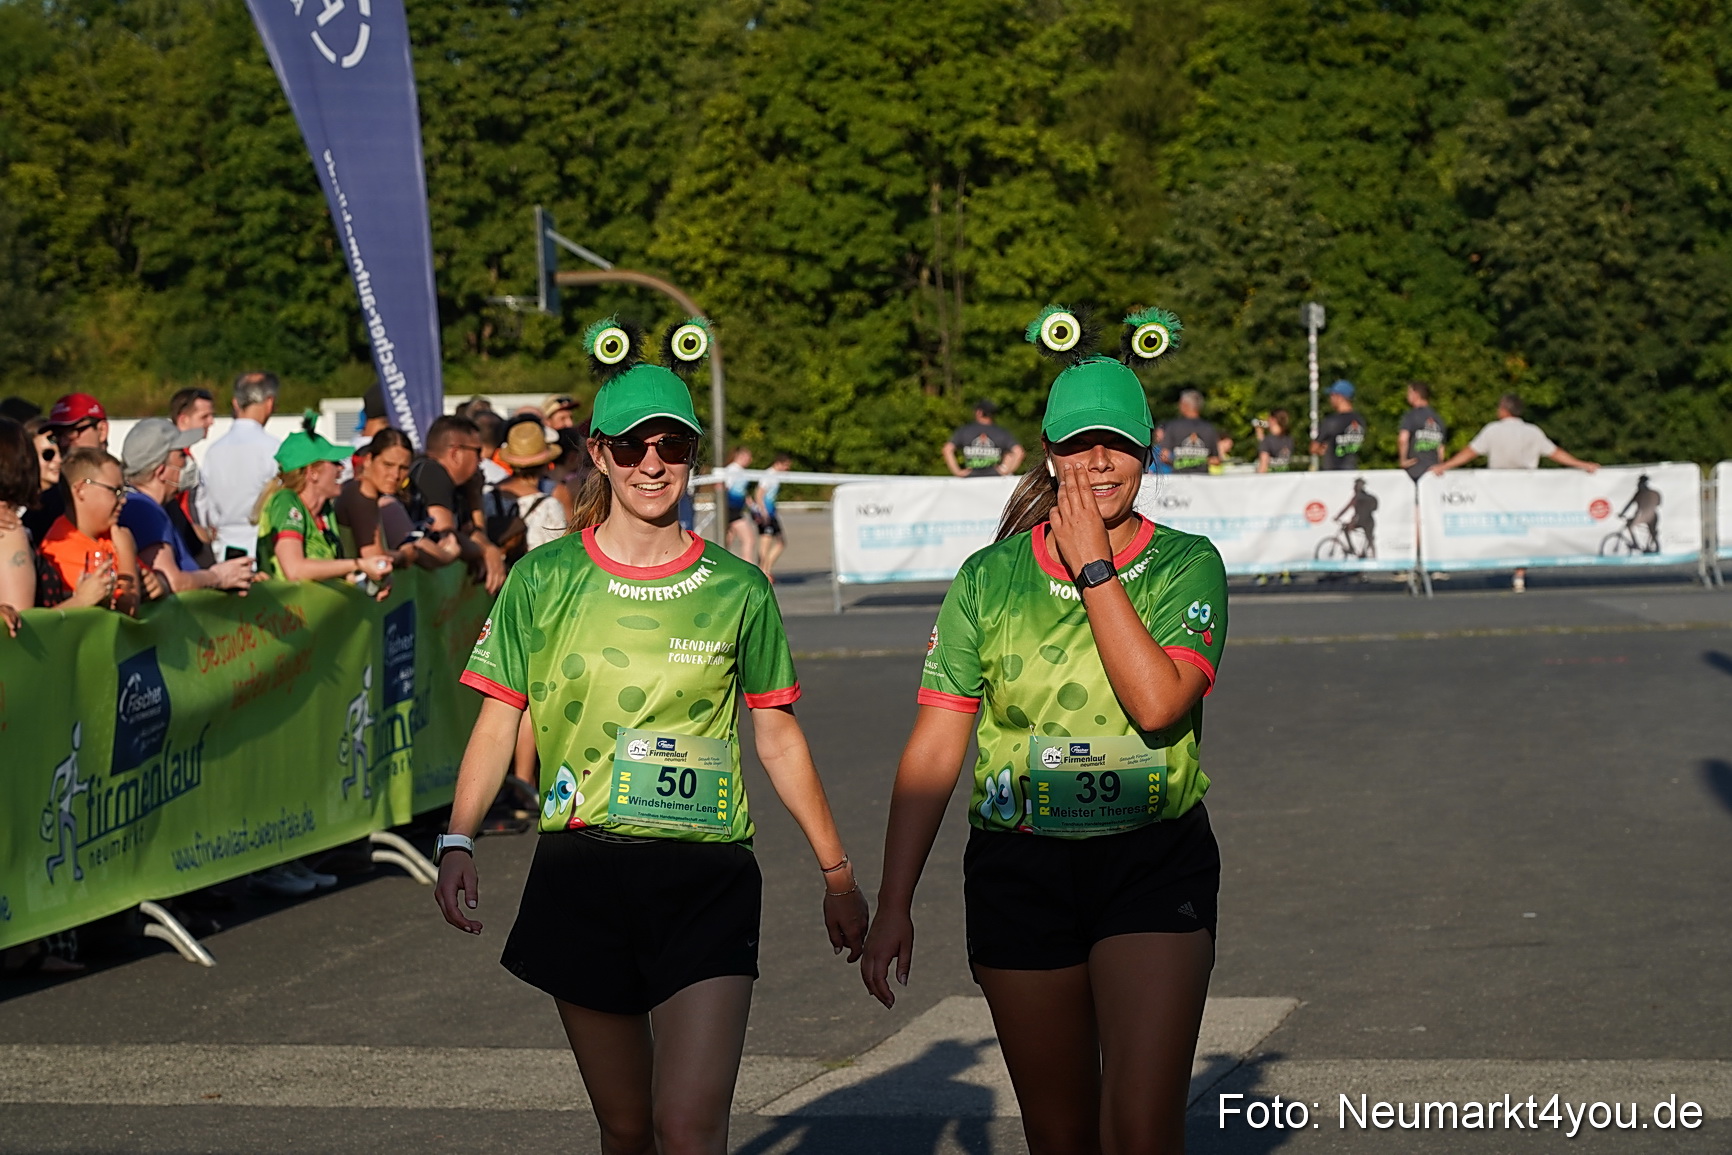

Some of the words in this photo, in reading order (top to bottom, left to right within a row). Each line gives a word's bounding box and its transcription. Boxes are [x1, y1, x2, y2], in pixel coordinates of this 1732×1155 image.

[669, 637, 735, 653] TRENDHAUS
[649, 750, 689, 758] Firmenlauf
[1064, 754, 1106, 764] Firmenlauf
[86, 721, 212, 843] firmenlauf
[617, 771, 632, 805] RUN
[656, 766, 697, 799] 50
[717, 777, 728, 821] 2022
[1038, 782, 1052, 816] RUN
[1075, 770, 1121, 804] 39
[1147, 772, 1160, 815] 2022
[628, 795, 695, 812] Windsheimer
[696, 802, 718, 814] Lena
[1050, 806, 1095, 818] Meister
[1099, 803, 1148, 817] Theresa
[88, 823, 145, 869] neumarkt
